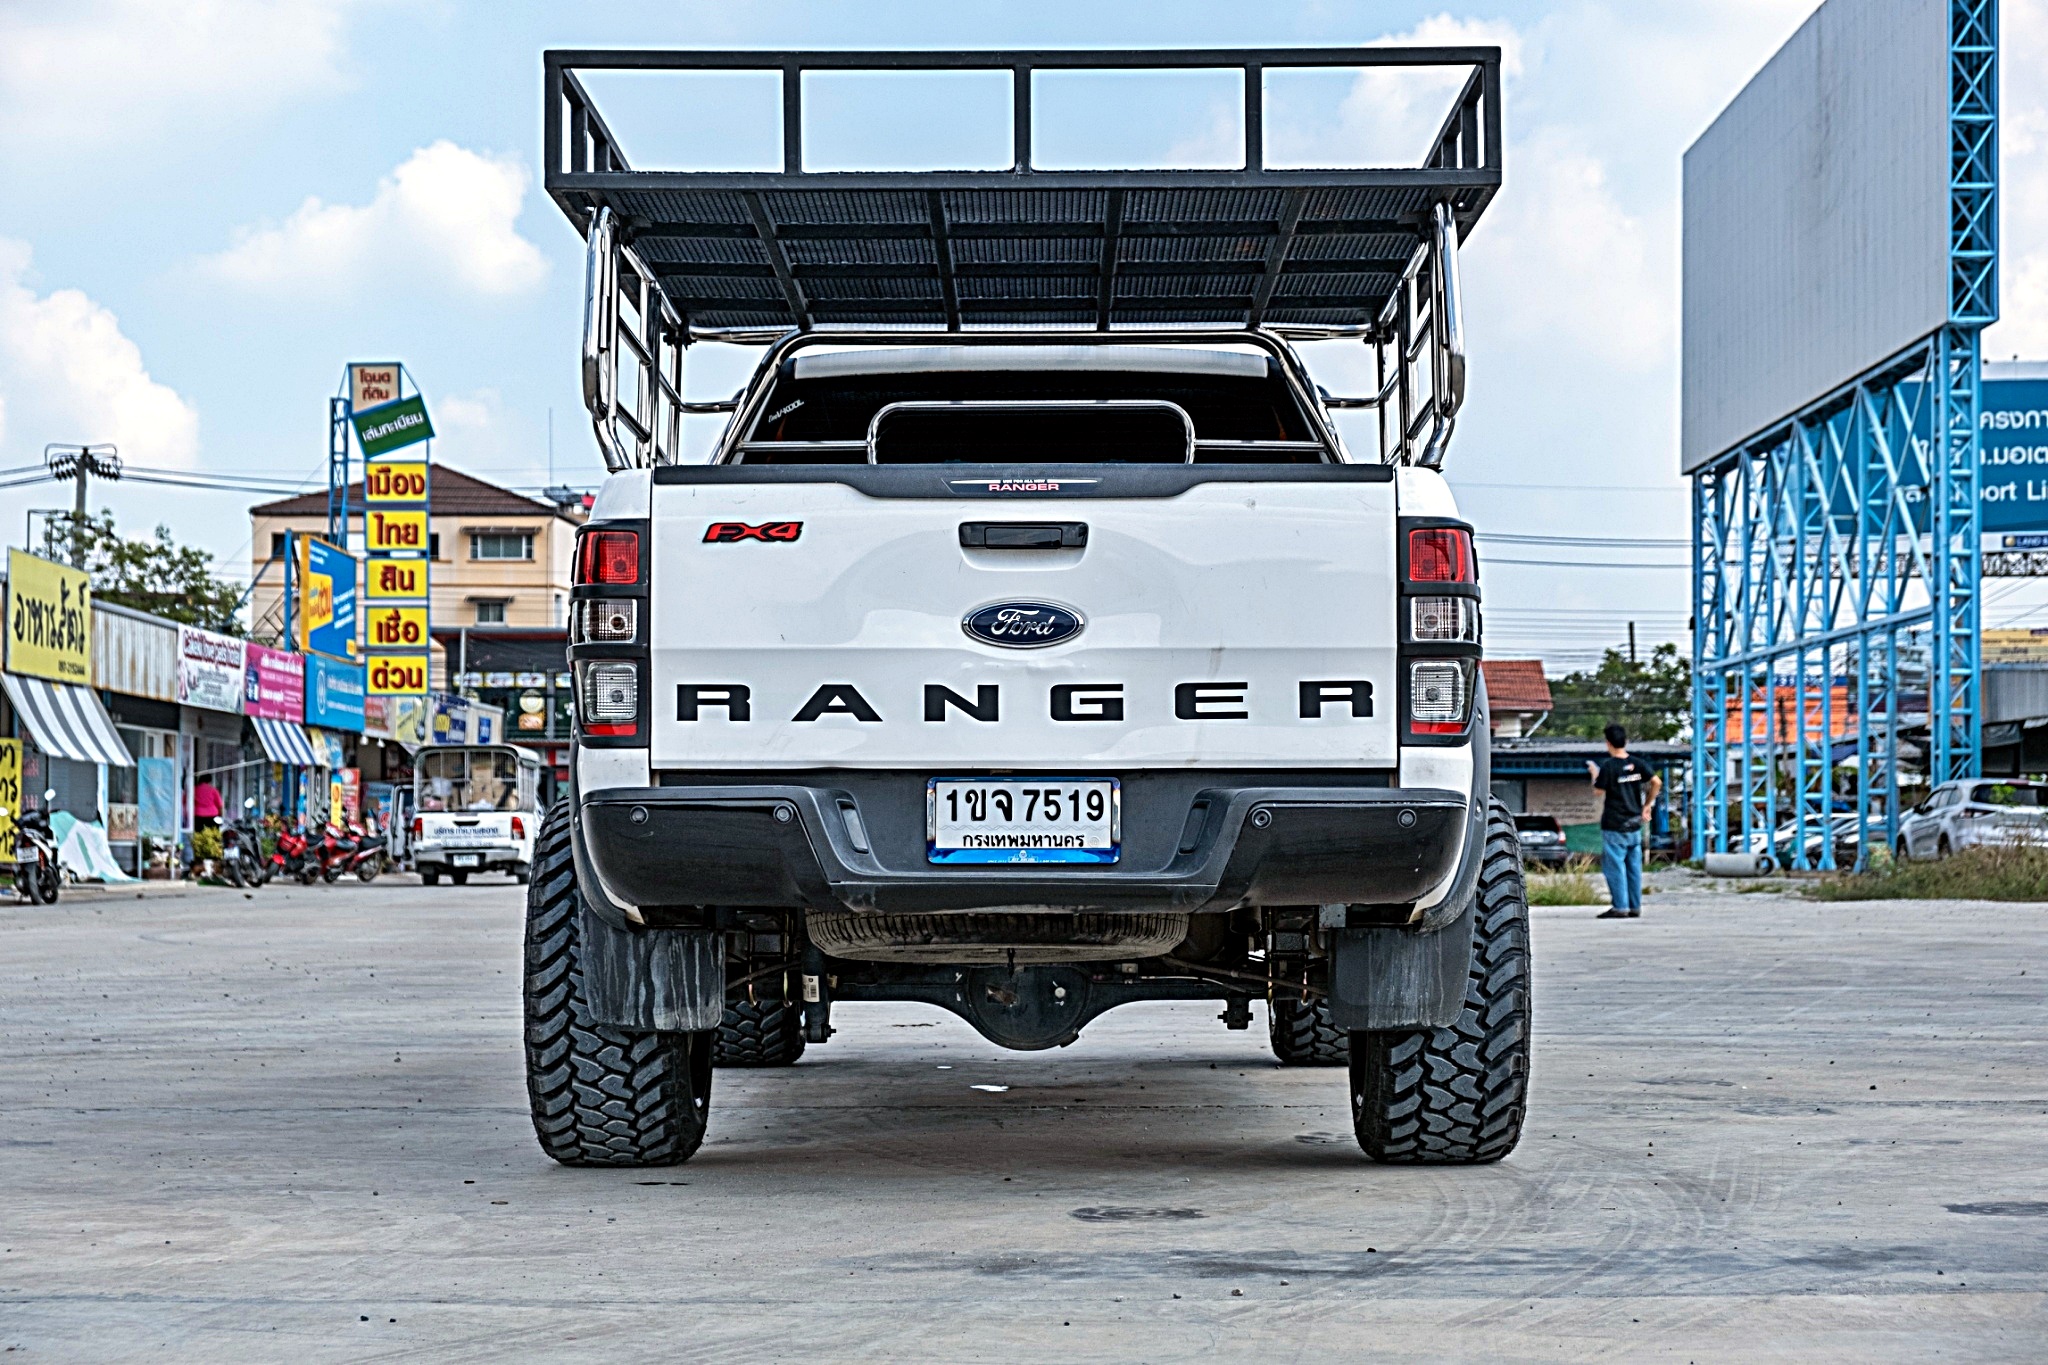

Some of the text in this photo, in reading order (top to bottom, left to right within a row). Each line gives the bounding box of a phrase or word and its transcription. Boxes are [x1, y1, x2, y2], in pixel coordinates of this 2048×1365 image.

[361, 412, 425, 442] เล่มทะเบียน
[366, 466, 426, 496] เมือง
[988, 483, 1059, 491] RANGER
[2026, 480, 2048, 501] Li
[373, 512, 419, 546] ไทย
[702, 521, 804, 543] FX4
[379, 563, 415, 592] สิน
[14, 576, 87, 655] อาหารสัตว์
[376, 607, 420, 643] เชื่อ
[990, 608, 1055, 636] Ford
[371, 660, 423, 689] ด่วน
[676, 680, 1374, 723] RANGER
[946, 788, 1105, 822] 1ขจ 7519
[962, 833, 1085, 848] กรงเทพมหานคร
